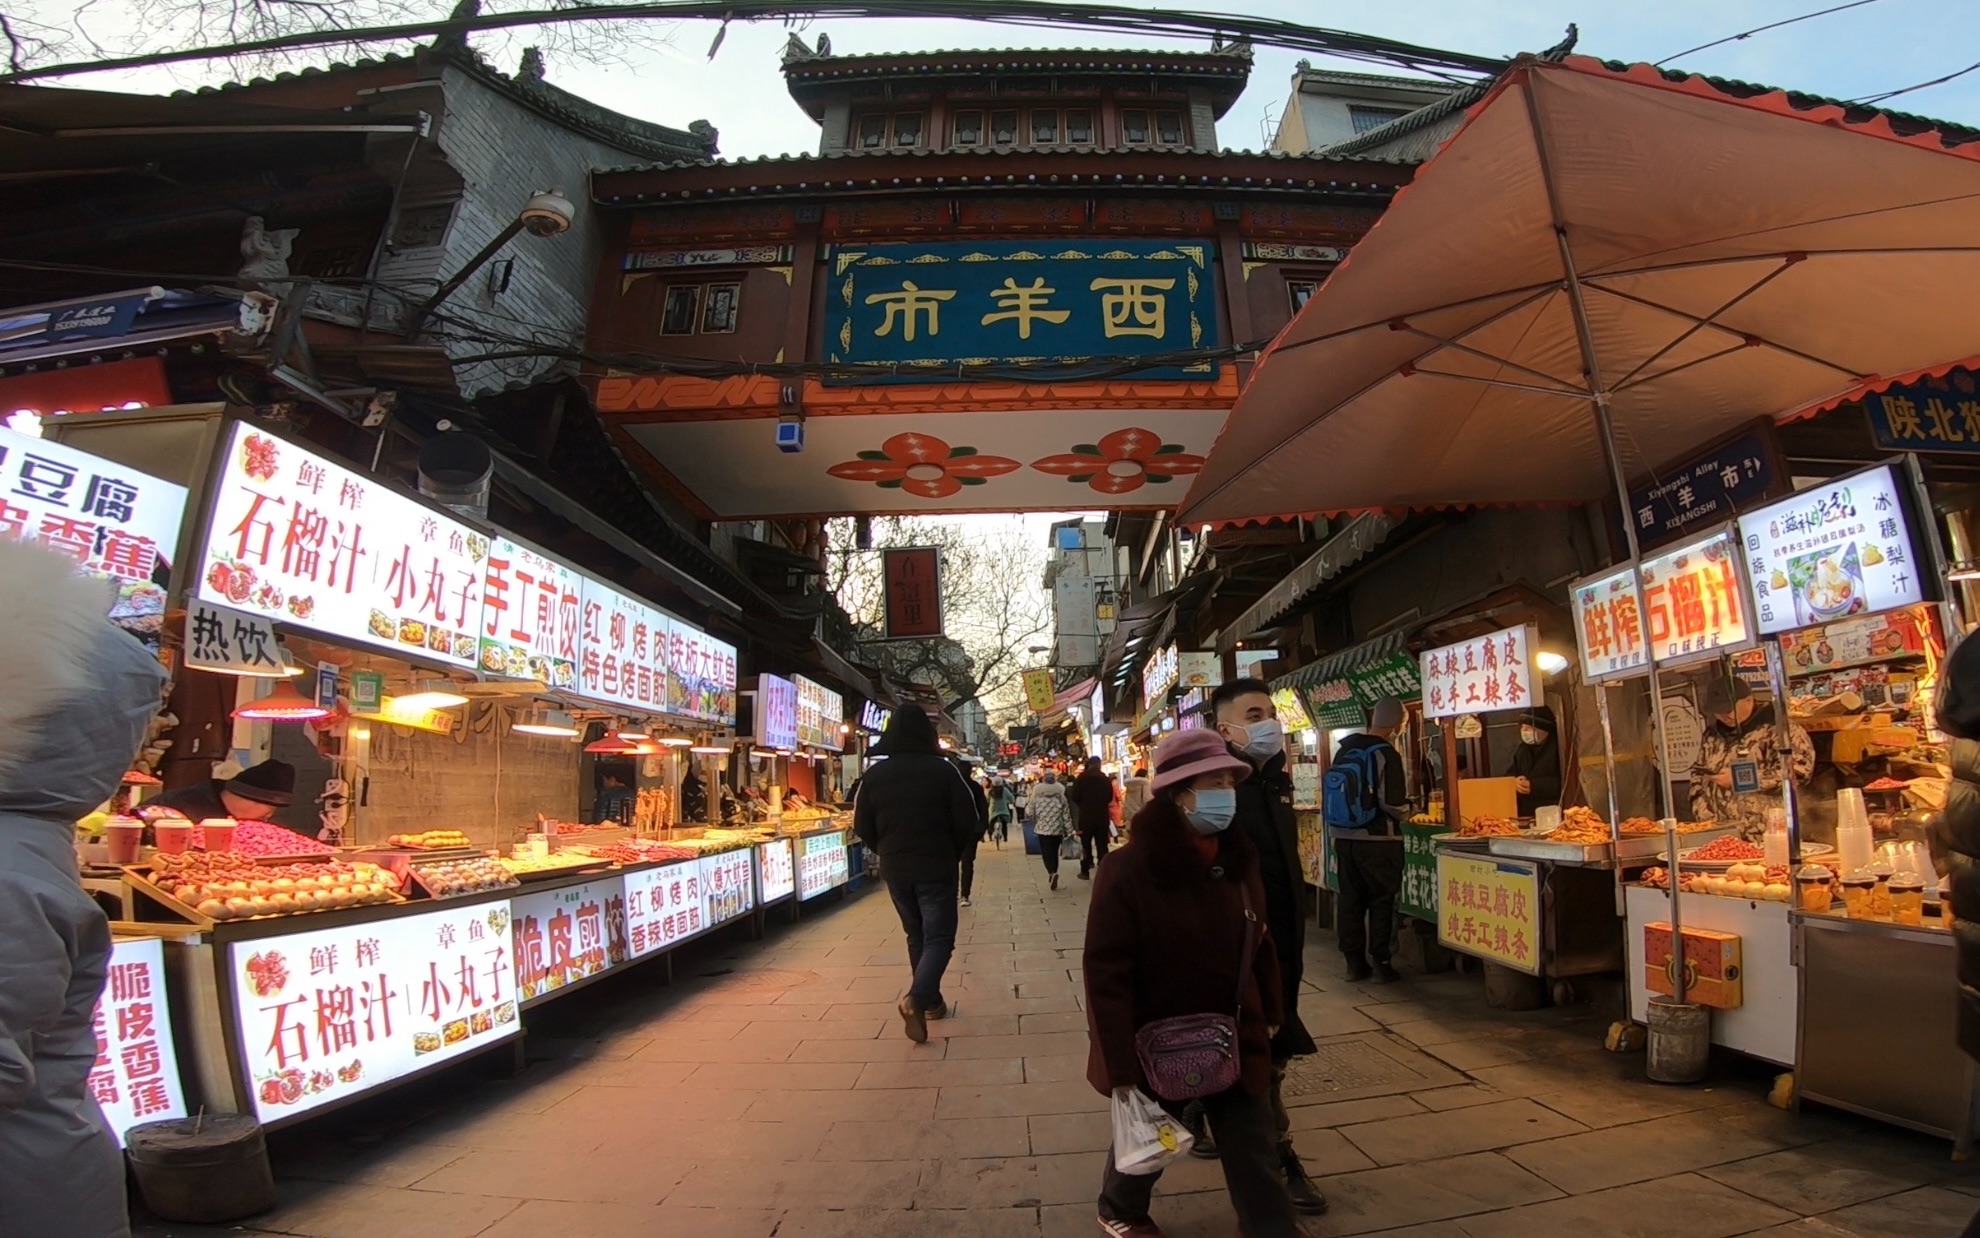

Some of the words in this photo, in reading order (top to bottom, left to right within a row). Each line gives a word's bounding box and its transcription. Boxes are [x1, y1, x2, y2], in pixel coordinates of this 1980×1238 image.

[0, 445, 139, 523] 豆腐
[296, 460, 366, 510] 鲜榨
[1695, 460, 1719, 478] Alley
[228, 485, 367, 594] 石榴汁
[419, 516, 464, 556] 章鱼
[1665, 500, 1718, 530] XIYANGSHI
[1873, 491, 1909, 593] 冰糖梨汁
[384, 544, 478, 629] 小丸子
[1747, 534, 1774, 622] 回族食品
[192, 607, 276, 667] 热饮
[485, 556, 578, 661] 手工煎饺
[583, 598, 667, 667] 红柳烤肉
[582, 646, 666, 706] 特色烤面筋
[669, 632, 736, 690] 铁板大鱿鱼
[1428, 632, 1521, 681] 麻辣豆腐皮
[1430, 669, 1526, 712] 纯手工辣条
[629, 876, 698, 919] 红柳烤肉
[703, 861, 751, 896] 火爆大鱿鱼
[1447, 878, 1528, 923] 麻辣豆腐皮
[308, 938, 381, 976] 鲜榨
[436, 919, 485, 950] 章鱼
[512, 894, 627, 988] 脆皮煎饺
[631, 905, 699, 953] 香辣烤面筋
[1447, 912, 1529, 960] 纯手工辣条
[260, 974, 397, 1069] 石榴汁
[421, 946, 508, 1021] 小丸子
[111, 962, 170, 1117] 脆皮香蕉
